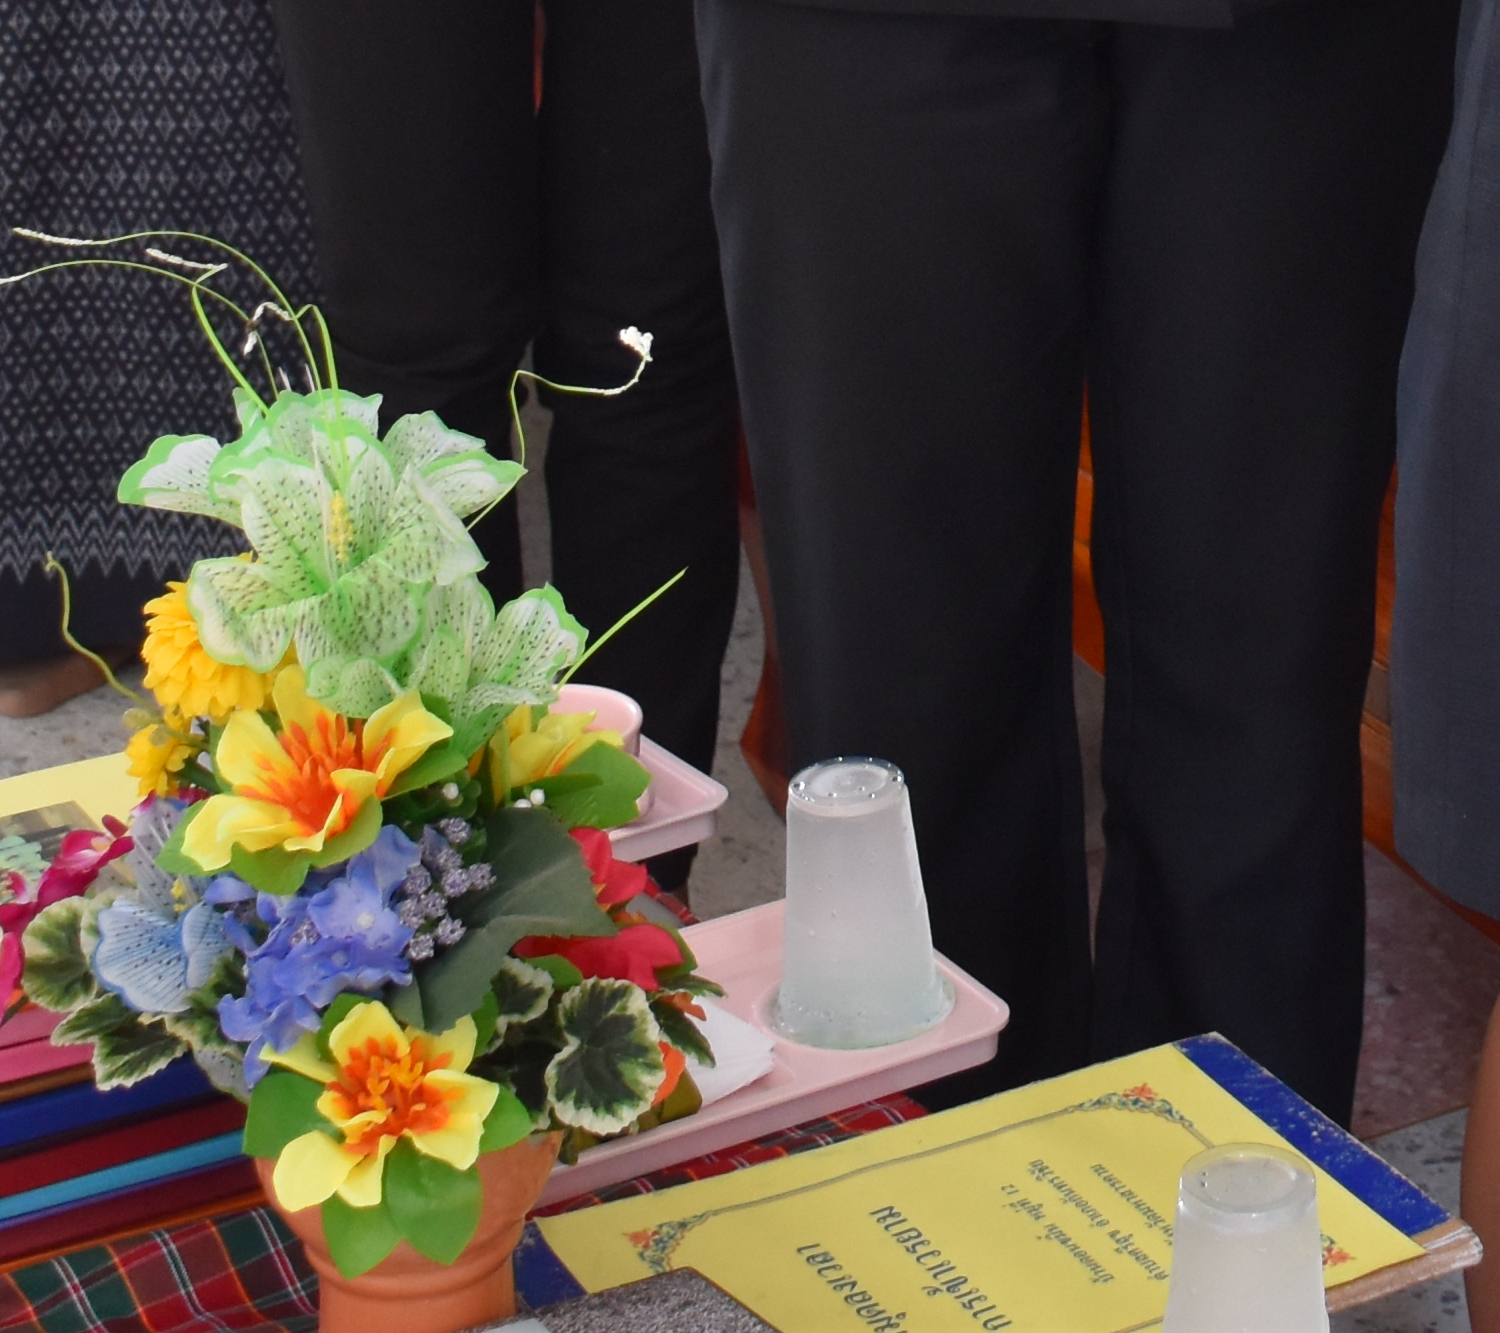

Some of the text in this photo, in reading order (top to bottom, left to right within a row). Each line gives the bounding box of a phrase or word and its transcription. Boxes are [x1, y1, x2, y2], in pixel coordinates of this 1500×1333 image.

[869, 1205, 1013, 1332] การเข้าเวรยาม
[1000, 1183, 1115, 1284] บ้านดอนขมิ้น หมู่ที่ 12
[796, 1242, 908, 1333] มุดลงเวลา
